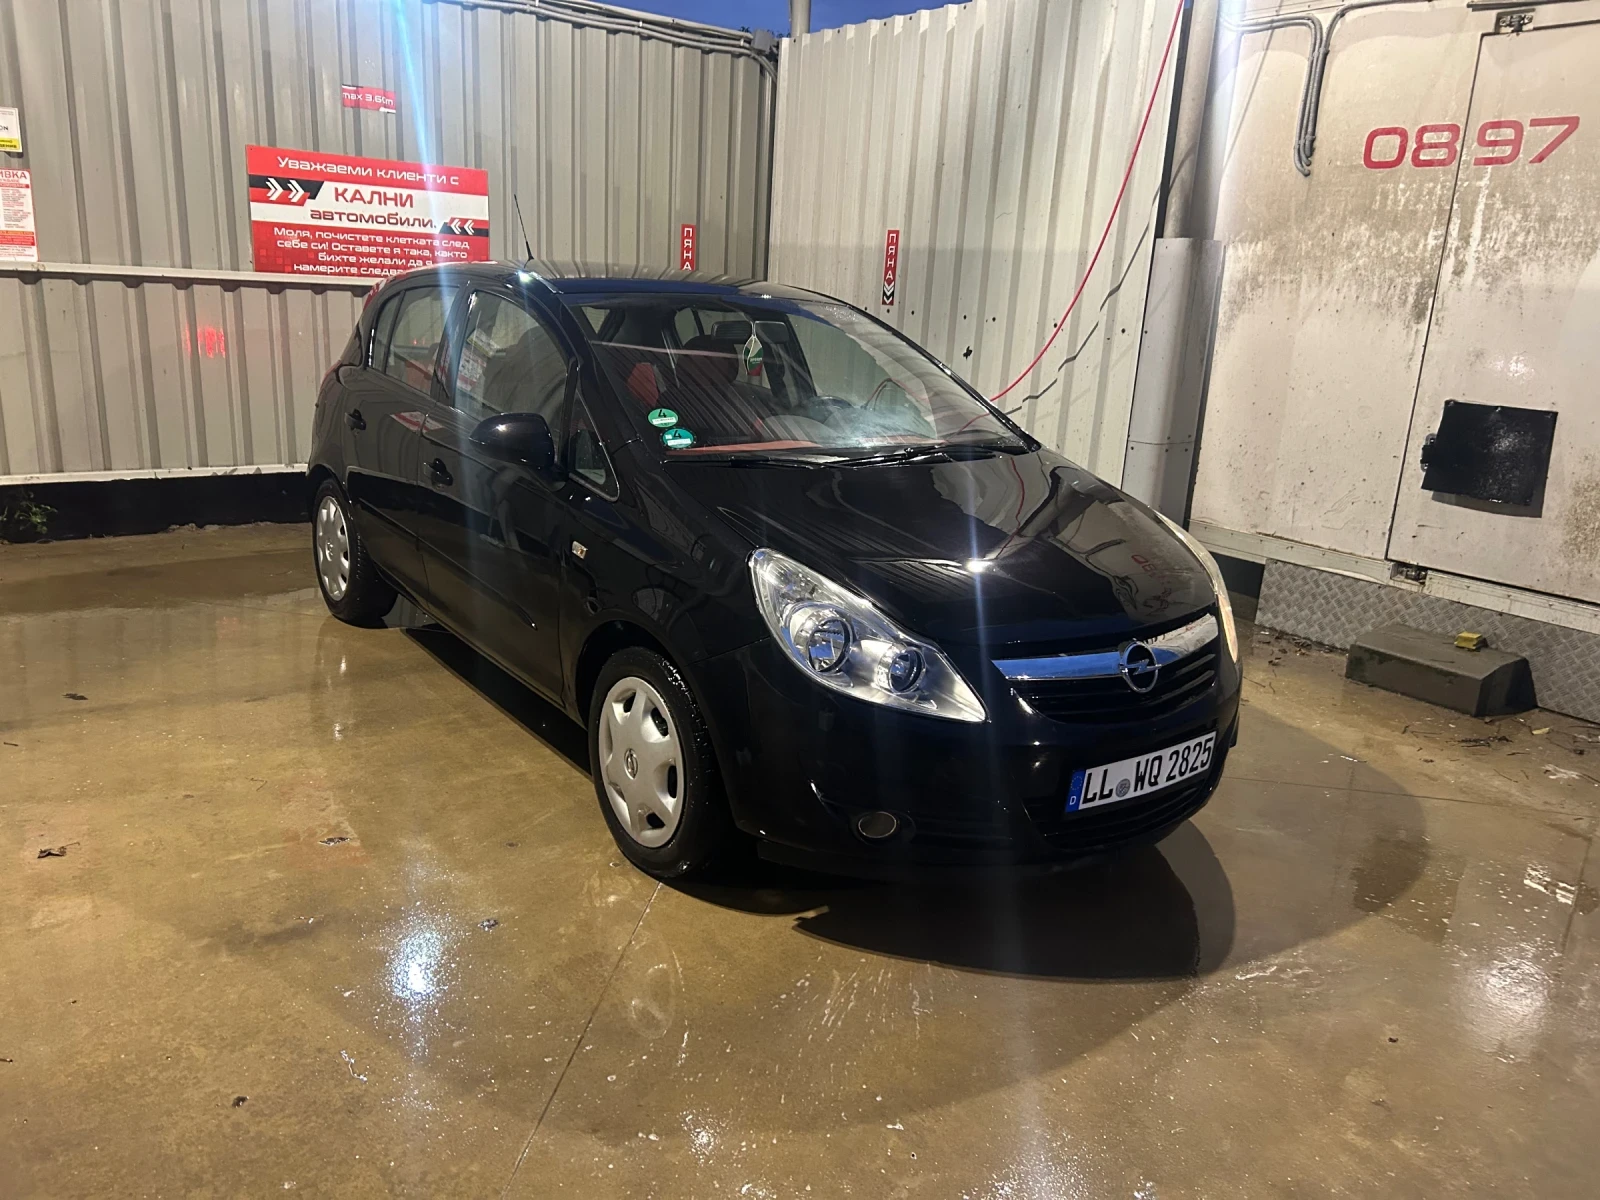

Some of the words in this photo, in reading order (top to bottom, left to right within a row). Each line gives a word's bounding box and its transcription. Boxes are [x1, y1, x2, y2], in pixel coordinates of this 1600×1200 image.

[343, 92, 362, 100] max
[277, 156, 372, 177] Уважаеми
[376, 168, 447, 185] клиенти
[450, 175, 460, 186] с
[334, 186, 414, 208] КАЛНИ
[310, 208, 437, 229] автомобили.
[273, 227, 313, 239] Моля,
[315, 230, 383, 243] почистете
[386, 236, 439, 247] клетката
[441, 240, 470, 250] след
[276, 239, 308, 249] себе
[310, 241, 329, 250] си!
[331, 242, 391, 254] Оставете
[403, 249, 432, 258] така,
[434, 250, 467, 259] както
[681, 227, 693, 271] ПЯНА
[318, 252, 357, 263] бихте
[359, 256, 406, 265] желали
[407, 259, 423, 267] да
[885, 233, 897, 280] ПЯНА
[293, 263, 358, 275] намерите
[657, 408, 667, 418] 4
[673, 429, 682, 439] 4
[1069, 795, 1077, 806] D
[1081, 768, 1114, 805] LL
[1133, 754, 1162, 793] WQ
[1165, 737, 1213, 782] 2825
